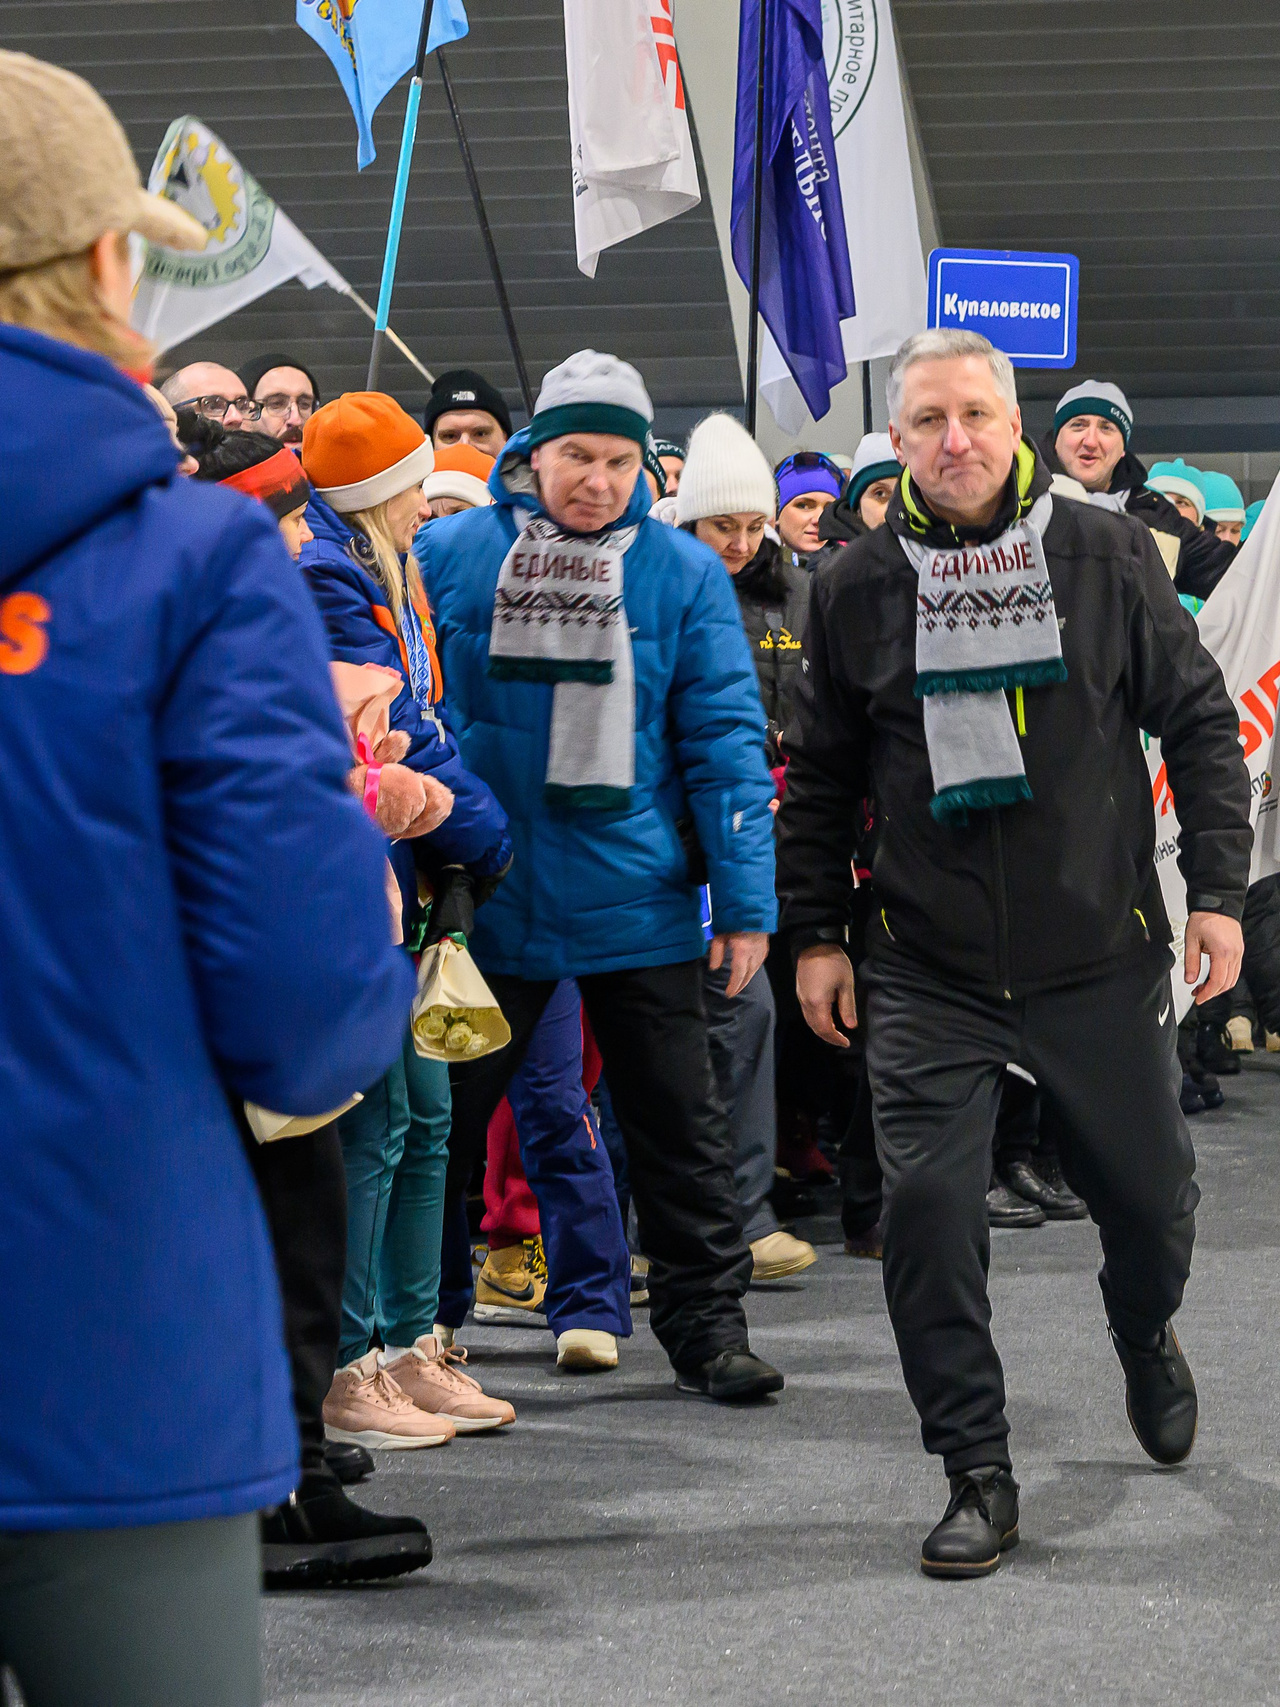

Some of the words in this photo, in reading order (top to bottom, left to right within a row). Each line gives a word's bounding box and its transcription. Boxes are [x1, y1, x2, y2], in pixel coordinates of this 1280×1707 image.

[829, 88, 850, 122] пр
[944, 292, 1061, 323] Купаловское
[511, 552, 612, 583] ЕДИНЫЕ
[930, 540, 1036, 582] ЕДИНЫЕ
[0, 590, 51, 676] S
